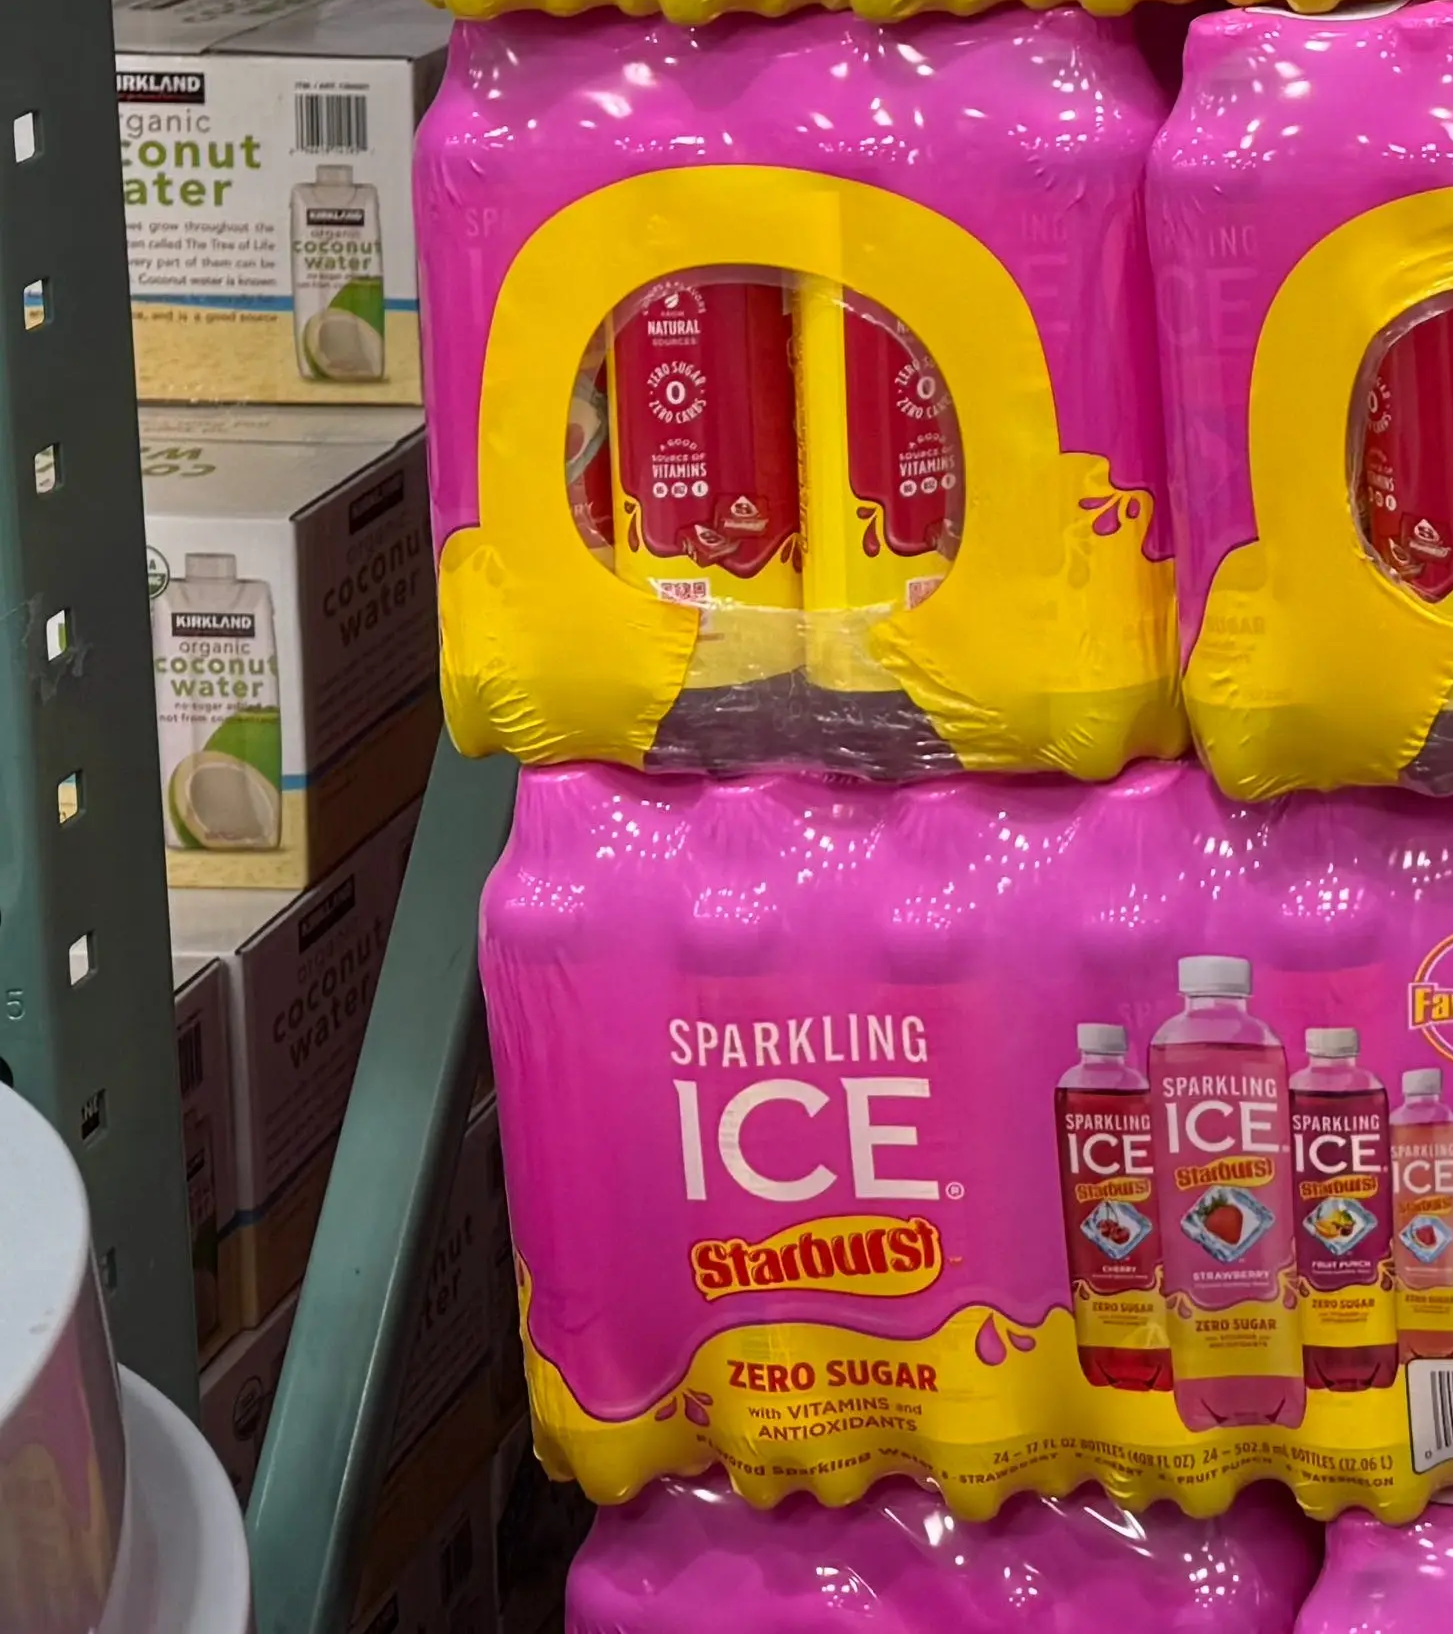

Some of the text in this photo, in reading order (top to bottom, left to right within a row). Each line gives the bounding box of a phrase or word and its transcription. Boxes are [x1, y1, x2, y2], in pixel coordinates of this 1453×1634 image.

[116, 74, 201, 93] IRKLAND
[124, 172, 232, 206] ater
[647, 319, 701, 336] NATURAL
[647, 360, 707, 388] ZERO SUGAR
[648, 398, 707, 424] ZERO CARBS
[652, 462, 707, 479] VITAMINS
[175, 615, 252, 629] KIRKLAND
[179, 640, 251, 657] organic
[171, 678, 264, 698] water
[670, 1014, 927, 1067] SPARKLING
[698, 1217, 941, 1298] Starburst
[728, 1360, 937, 1392] ZERO SUGAR
[787, 1397, 889, 1419] VITAMINS
[758, 1416, 918, 1441] ANTIOXIDANTS
